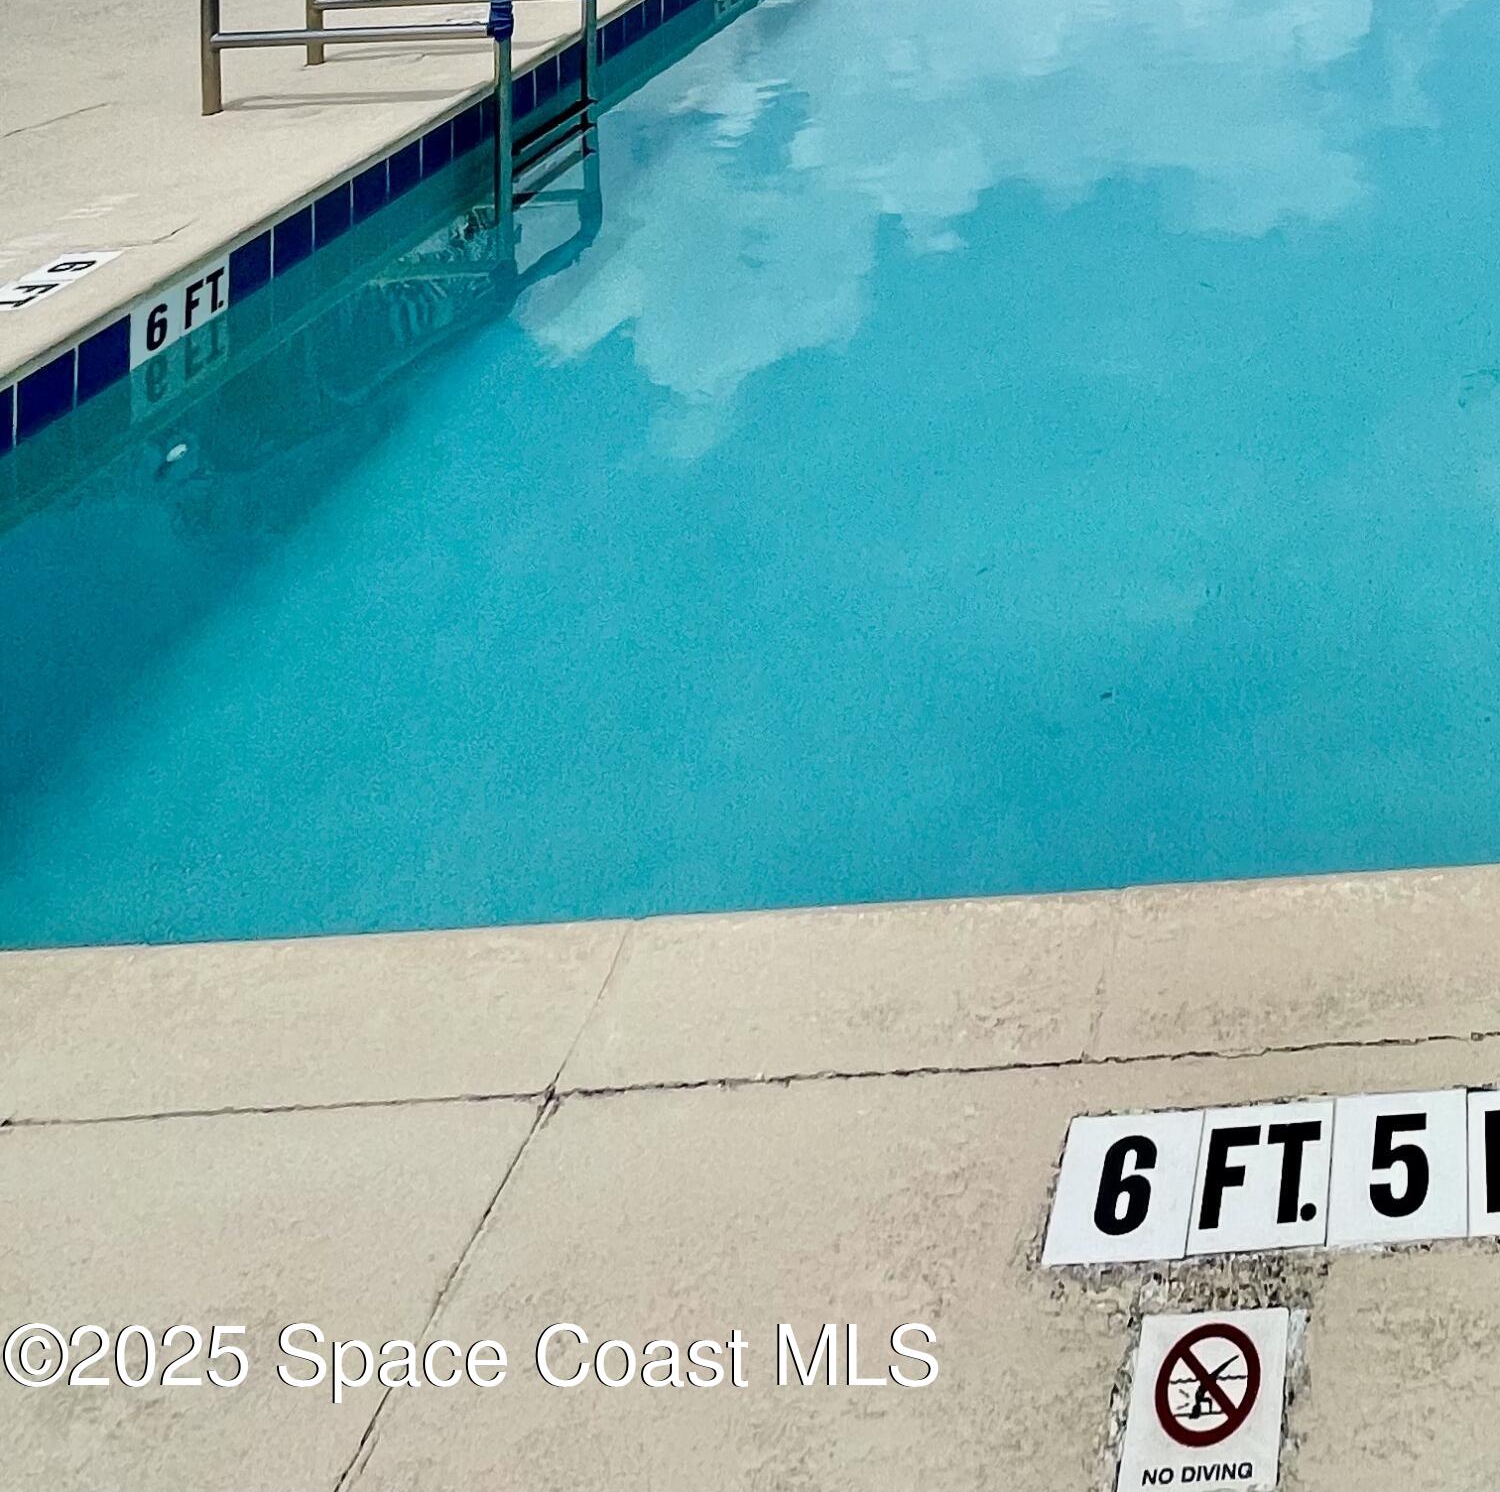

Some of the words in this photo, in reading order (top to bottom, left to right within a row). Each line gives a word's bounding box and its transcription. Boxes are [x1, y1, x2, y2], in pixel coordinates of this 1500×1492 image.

[47, 260, 97, 273] 6
[146, 303, 168, 352] 6
[184, 266, 225, 330] FT.
[1092, 1134, 1158, 1236] 6
[1198, 1120, 1322, 1230] FT.
[1369, 1112, 1430, 1218] 5
[1141, 1467, 1175, 1487] NO
[1181, 1461, 1253, 1483] DIVING
